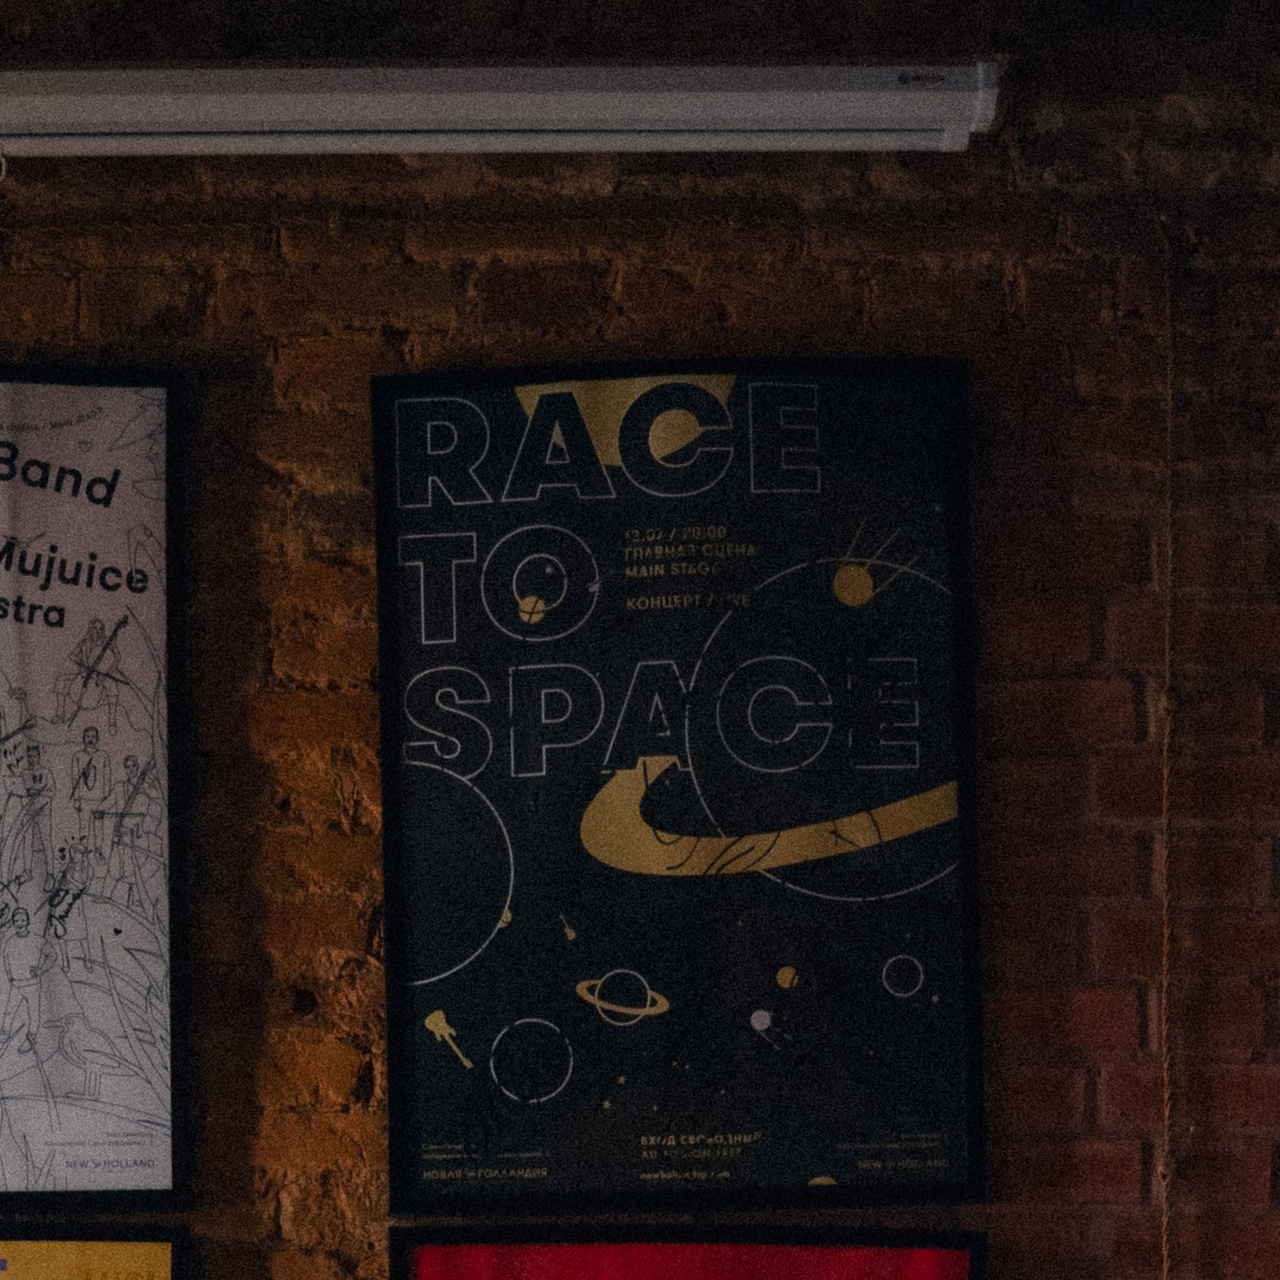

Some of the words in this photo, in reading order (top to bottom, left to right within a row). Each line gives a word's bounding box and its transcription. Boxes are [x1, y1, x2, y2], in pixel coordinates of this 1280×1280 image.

[394, 381, 821, 509] RACE
[397, 524, 600, 645] TO
[625, 563, 666, 578] MAIN
[403, 654, 921, 780] SPACE
[103, 1159, 155, 1168] HOLLAND
